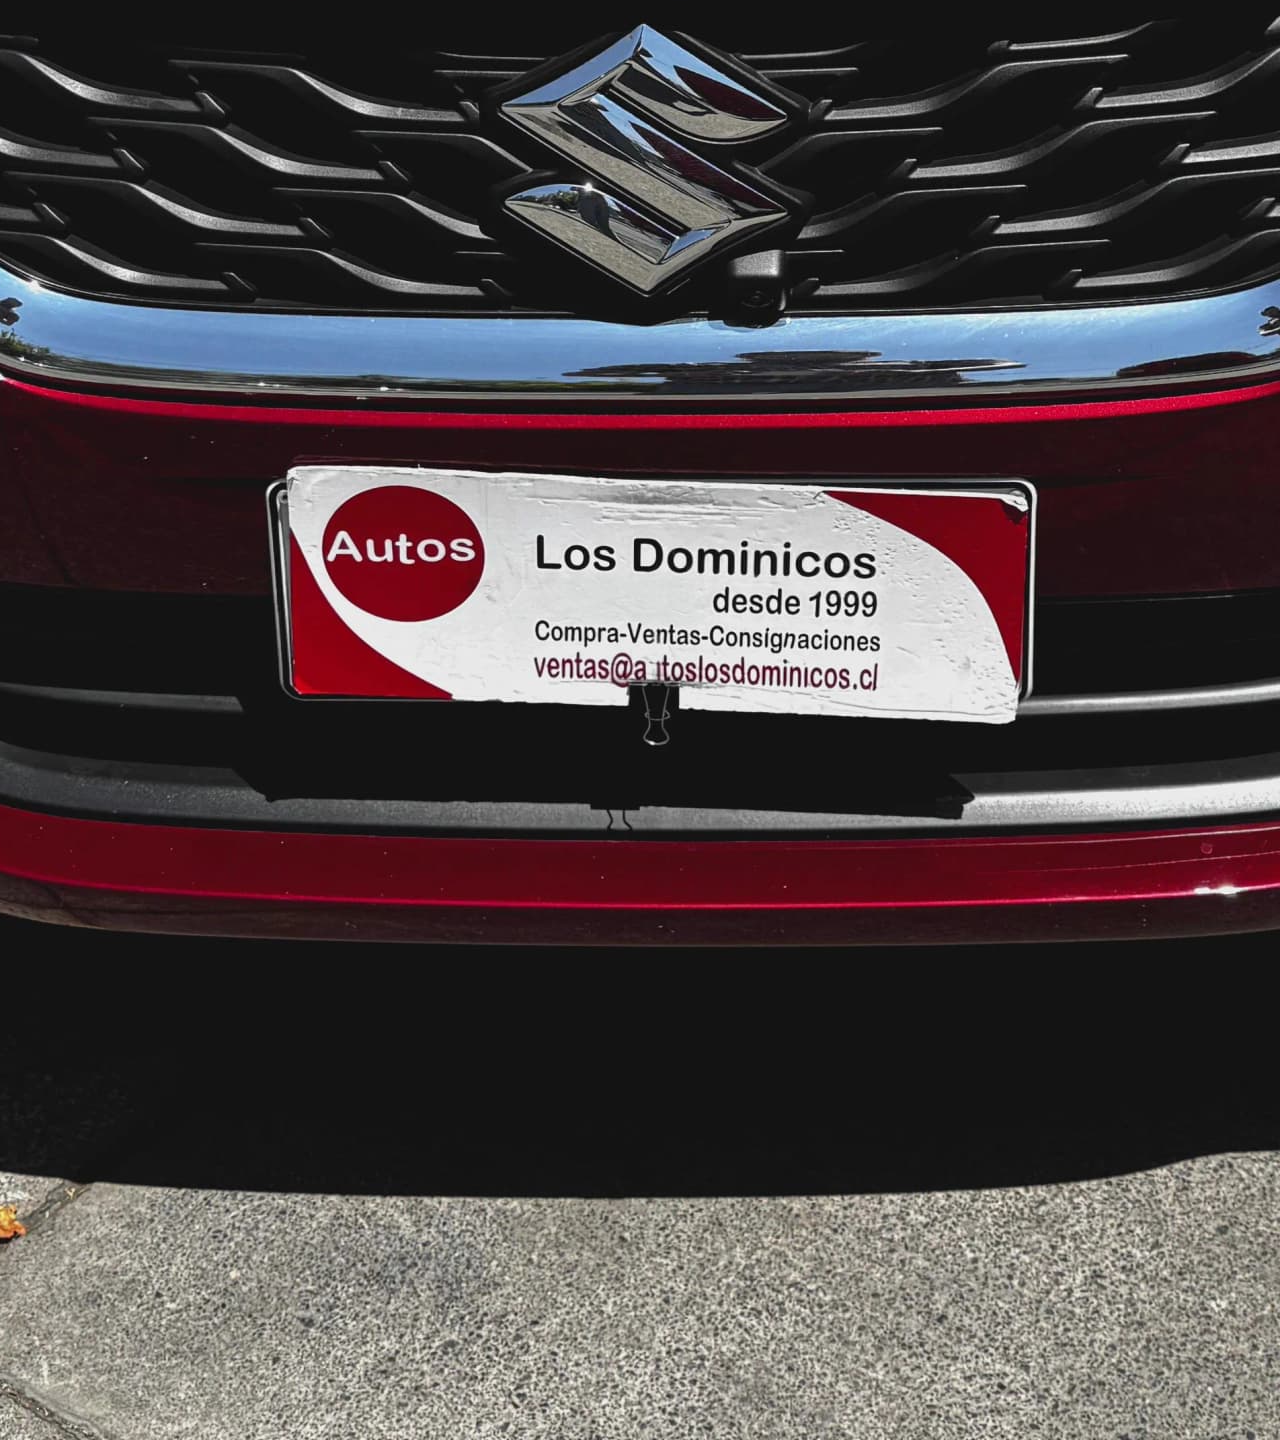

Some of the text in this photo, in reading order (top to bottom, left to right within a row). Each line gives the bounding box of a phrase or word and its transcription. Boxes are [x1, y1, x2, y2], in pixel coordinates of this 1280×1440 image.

[326, 530, 477, 565] Autos
[536, 535, 878, 580] Los Dominicos
[713, 587, 878, 618] desde 1999
[535, 620, 881, 654] Compra-Ventas-Consignaciones
